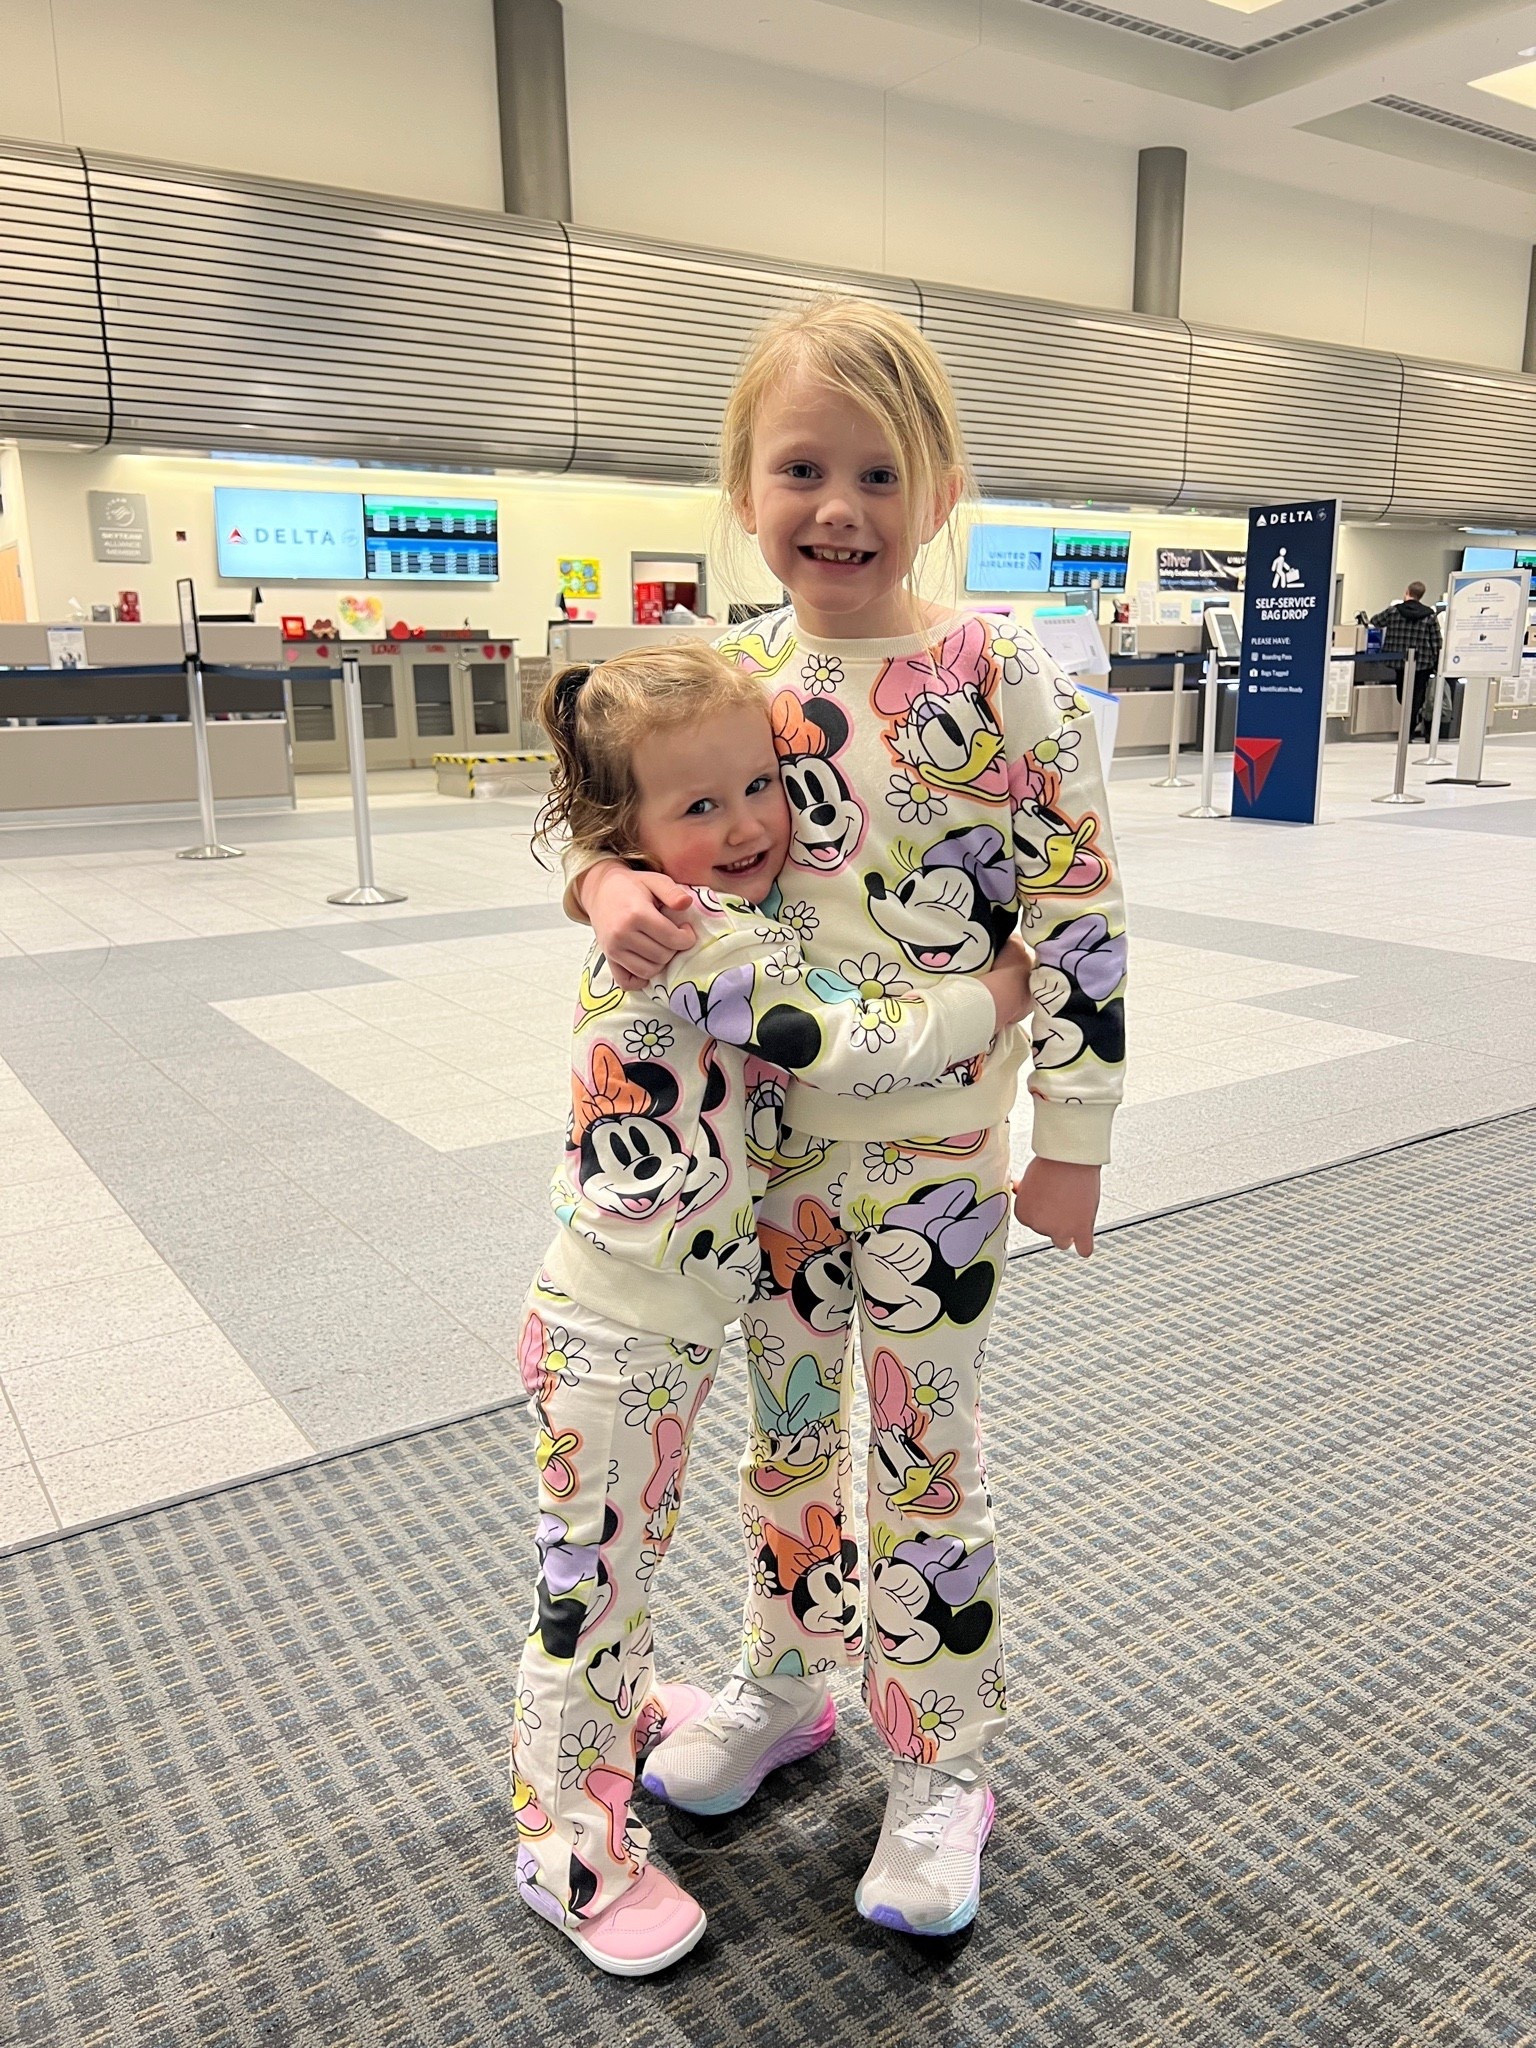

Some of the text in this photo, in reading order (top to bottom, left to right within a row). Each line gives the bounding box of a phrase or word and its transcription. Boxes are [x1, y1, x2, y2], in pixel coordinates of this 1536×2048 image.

[1270, 510, 1313, 525] DELTA
[255, 527, 336, 546] DELTA
[989, 551, 1026, 560] UNITED
[1160, 551, 1192, 568] Silver
[1226, 556, 1246, 564] UNIT
[981, 560, 1026, 569] AIRLINES
[1255, 597, 1316, 609] SELF-SERVICE
[1261, 609, 1309, 620] BAG DROP
[1251, 637, 1291, 645] PLEASE HAVE:
[371, 643, 400, 655] LOVE
